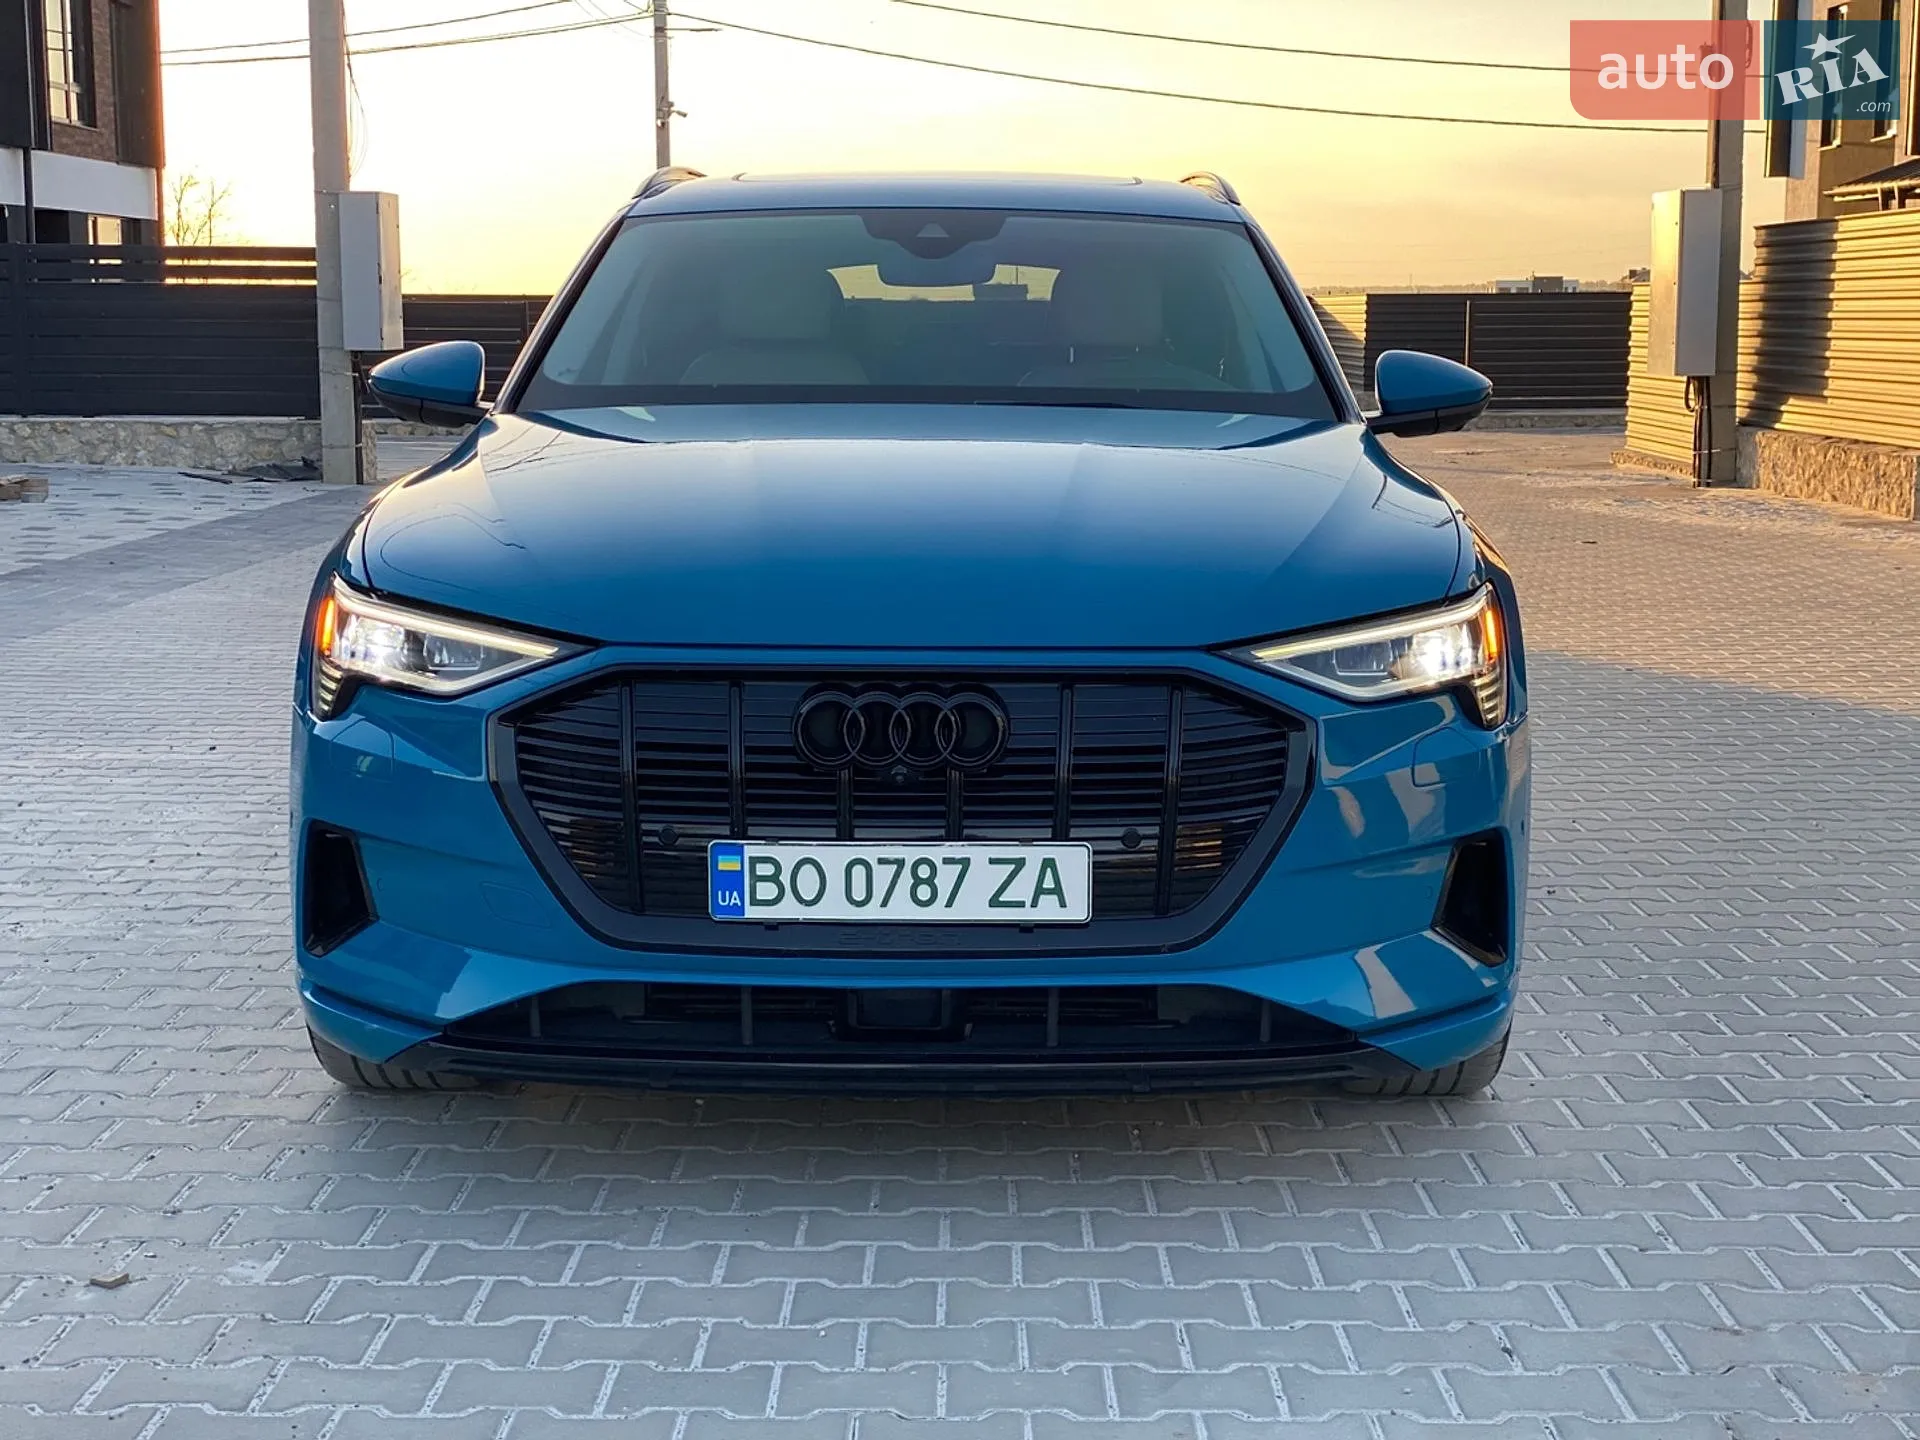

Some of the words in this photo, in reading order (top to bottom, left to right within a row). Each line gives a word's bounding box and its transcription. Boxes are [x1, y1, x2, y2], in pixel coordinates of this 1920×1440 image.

[718, 891, 741, 906] UA
[748, 856, 827, 907] BO
[843, 857, 972, 908] 0787
[988, 856, 1068, 908] ZA
